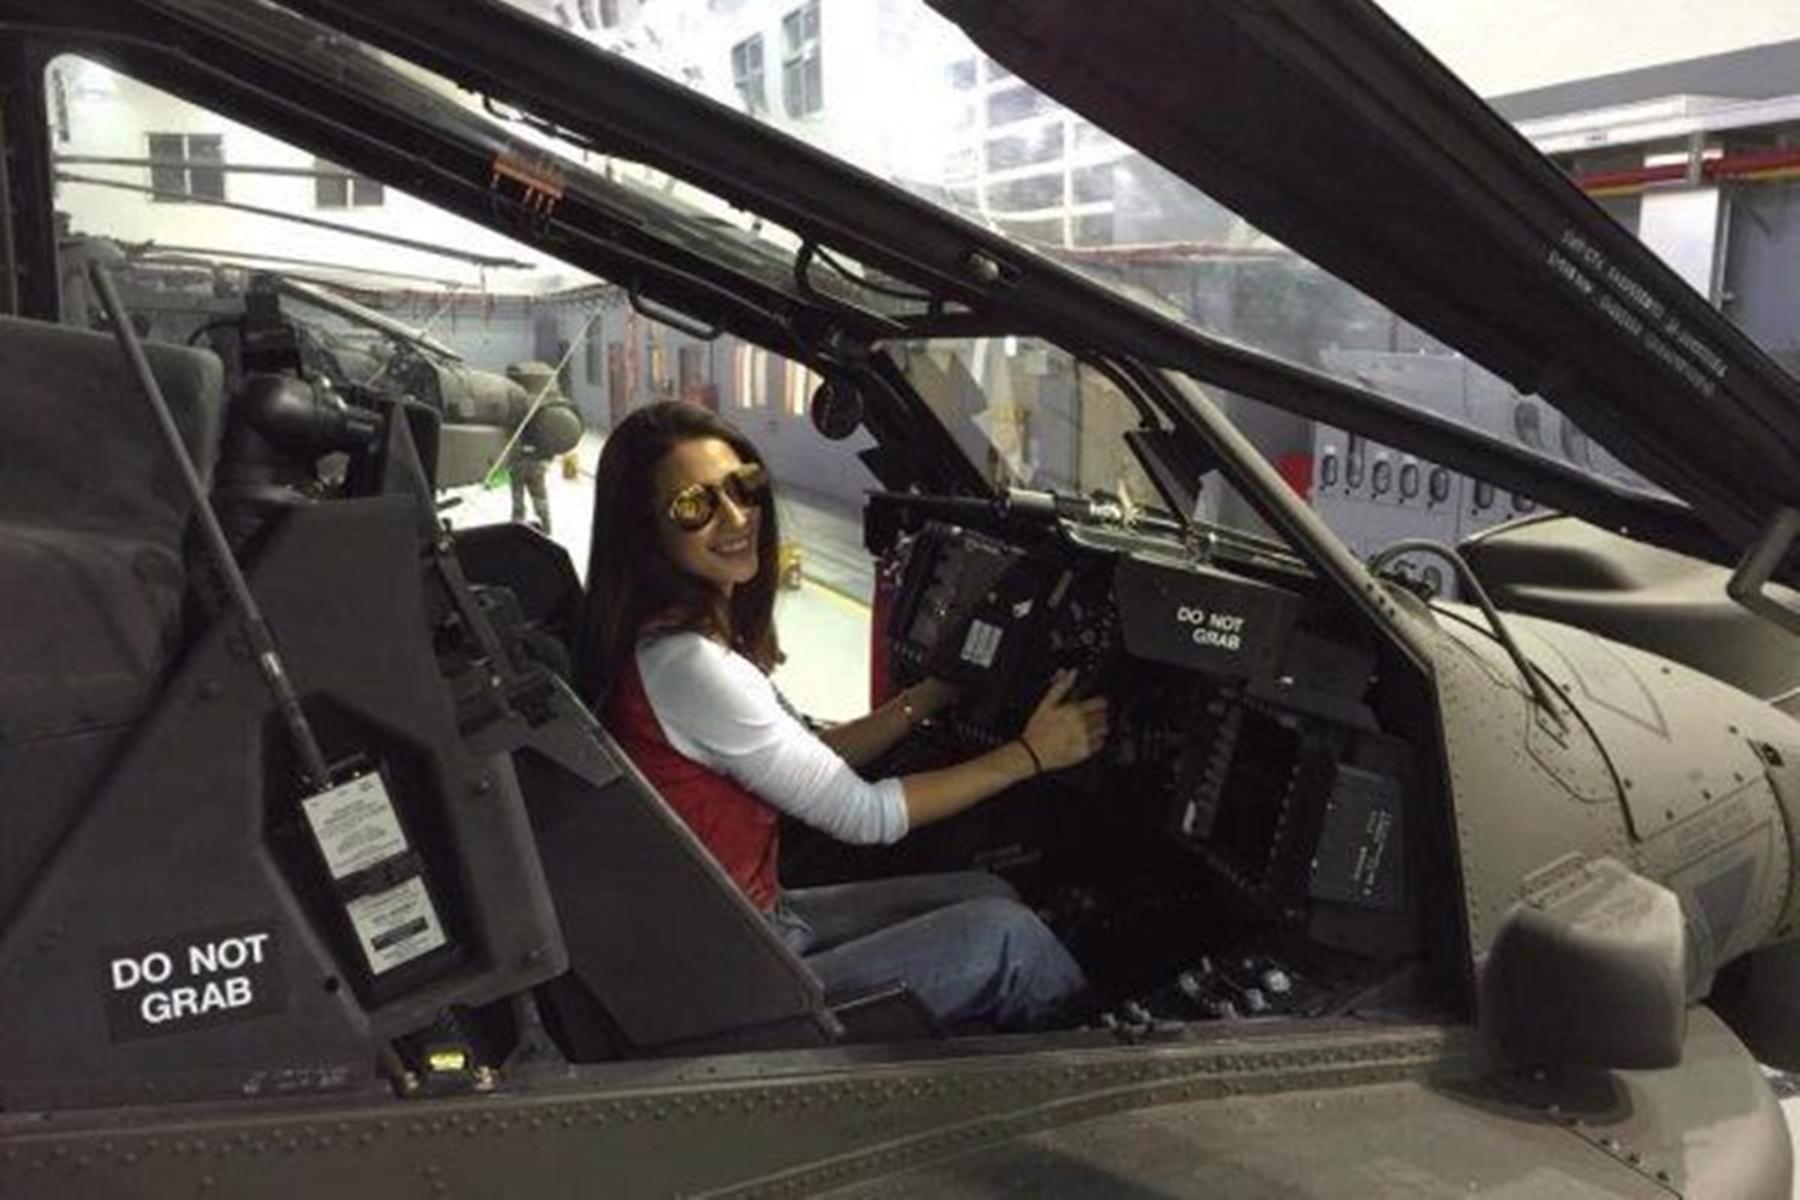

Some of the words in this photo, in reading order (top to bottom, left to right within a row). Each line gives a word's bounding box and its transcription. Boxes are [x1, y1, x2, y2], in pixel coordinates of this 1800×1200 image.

[1177, 606, 1204, 625] DO
[1209, 613, 1244, 633] NOT
[1192, 627, 1241, 651] GRAB
[111, 952, 173, 990] DO
[188, 933, 269, 975] NOT
[141, 976, 253, 1024] GRAB
